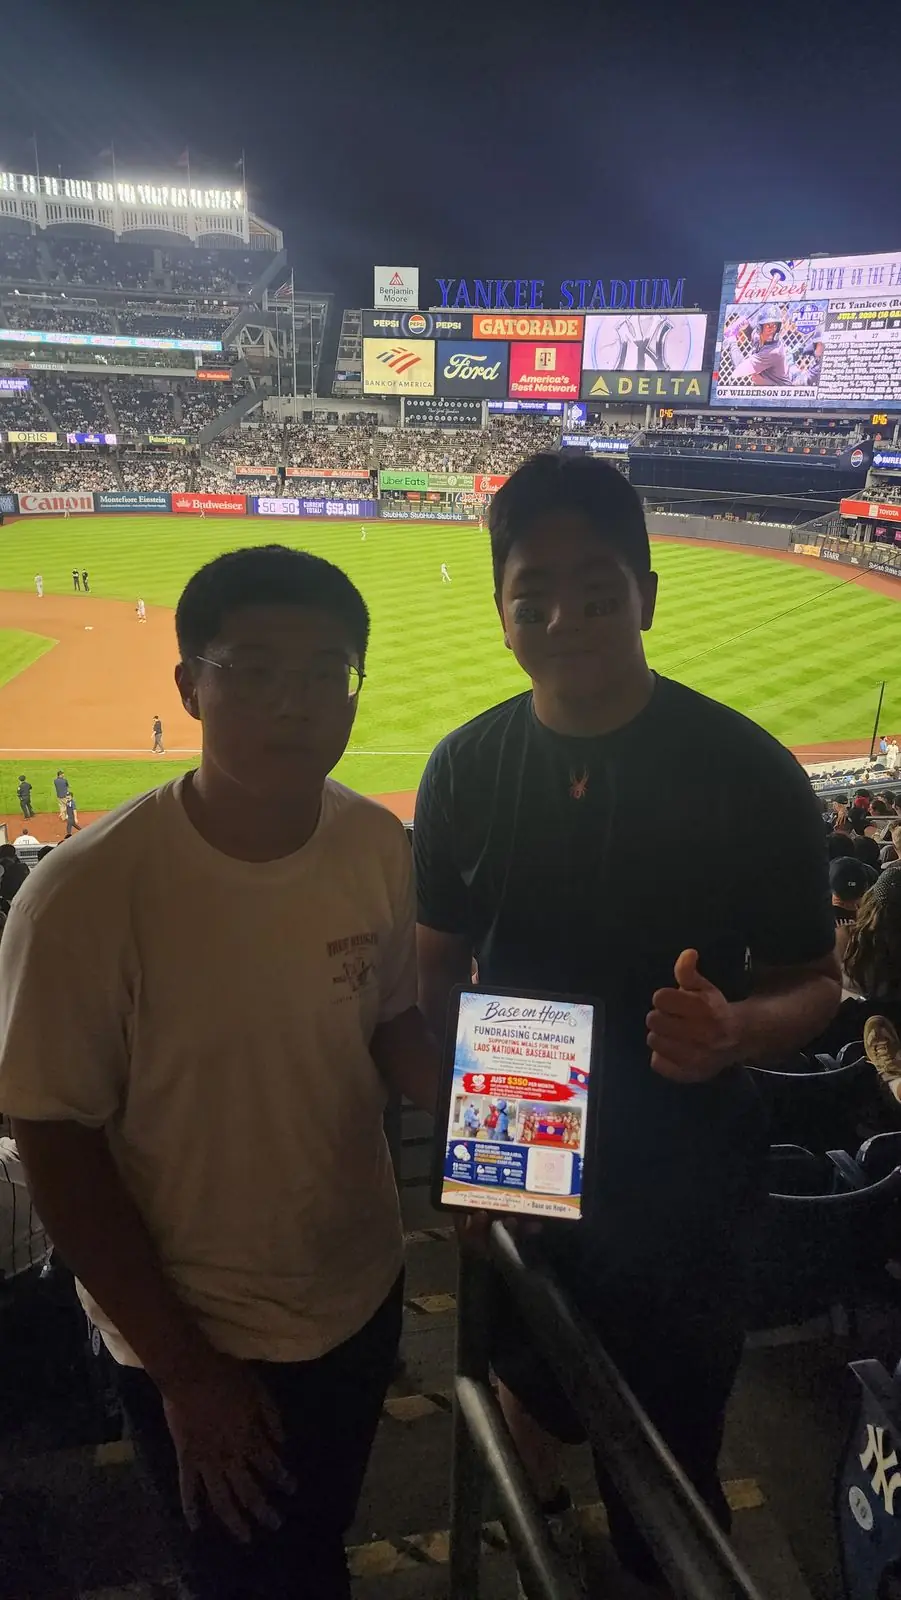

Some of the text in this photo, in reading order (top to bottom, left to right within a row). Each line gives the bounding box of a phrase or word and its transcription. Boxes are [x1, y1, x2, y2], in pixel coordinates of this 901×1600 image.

[379, 287, 414, 298] Benjamin
[435, 278, 687, 310] YANKEE STADIUM
[384, 294, 408, 304] Moore
[848, 300, 886, 309] Yankees
[373, 320, 400, 328] PEPSI
[436, 321, 462, 330] PEPSI
[479, 319, 578, 336] GATORADE
[444, 353, 502, 380] Ford
[520, 374, 570, 384] America's
[512, 384, 577, 393] Best Network
[617, 376, 701, 396] DELTA
[730, 389, 779, 398] WILBERSON
[780, 389, 792, 397] DE
[18, 432, 48, 442] ORIS
[382, 476, 403, 485] Uber
[404, 477, 426, 486] Eats
[20, 495, 92, 511] Canon
[192, 499, 243, 511] Budweiser
[262, 502, 296, 513] 50 50
[879, 508, 900, 517] TOYOTA
[823, 551, 840, 560] STARR
[480, 1002, 570, 1026] Base on Hope
[474, 1026, 575, 1044] FUNDRAISING CAMPAIGN
[488, 1038, 520, 1046] SUPPORTING
[474, 1043, 576, 1061] LAOS NATIONAL BASEBALL TEAM
[507, 1077, 528, 1086] $350
